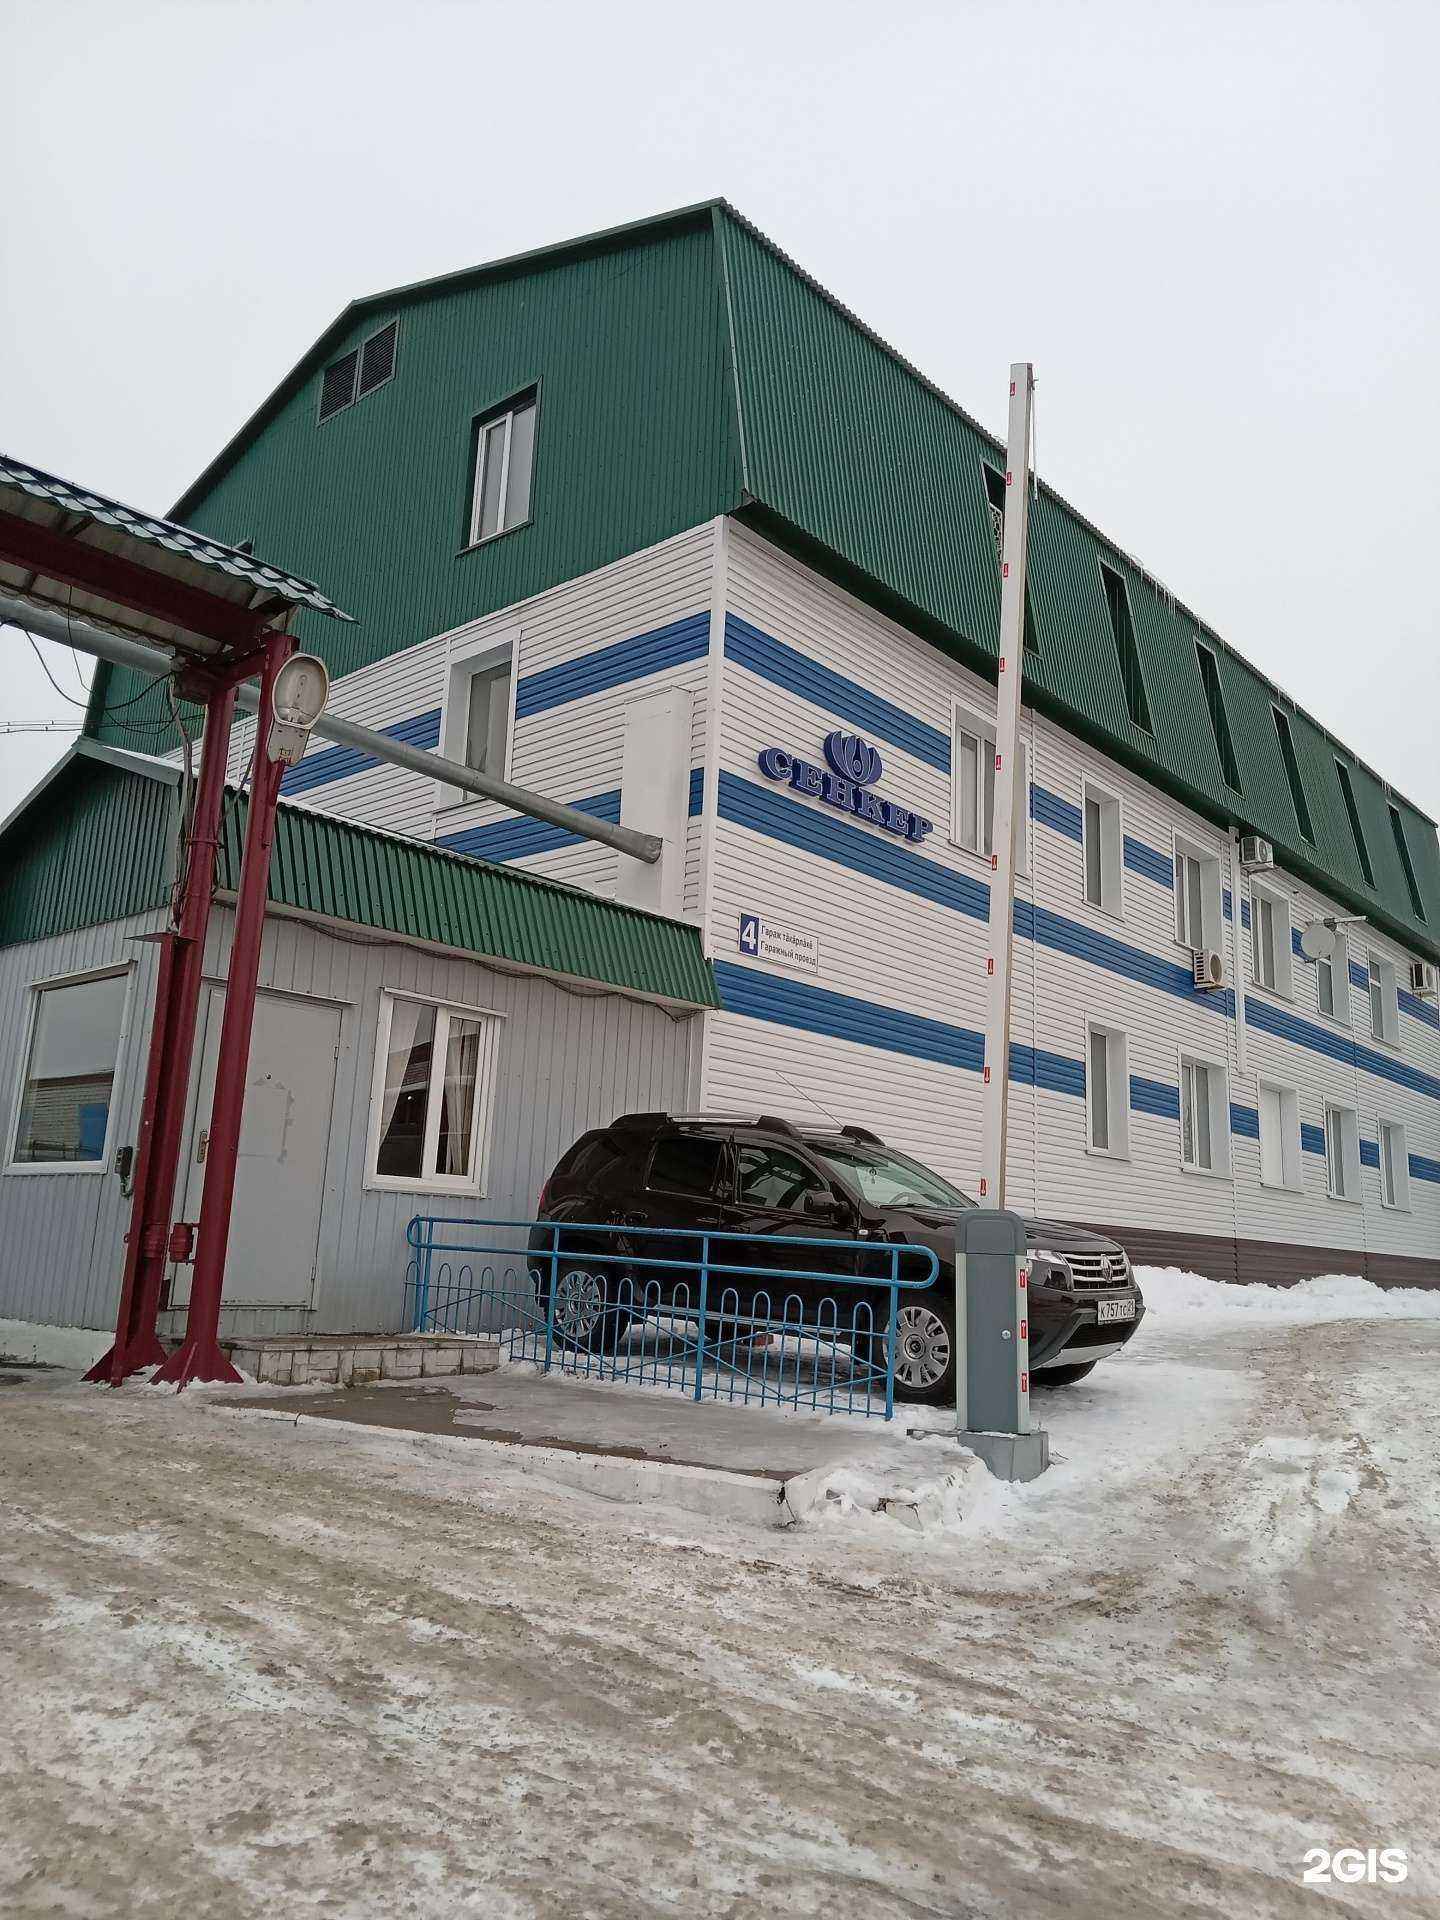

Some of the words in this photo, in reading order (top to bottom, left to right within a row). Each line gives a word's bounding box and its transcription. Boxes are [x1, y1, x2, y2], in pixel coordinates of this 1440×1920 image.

[758, 747, 934, 843] СЕНКЕР
[741, 920, 757, 950] 4
[761, 925, 781, 941] Гараж
[760, 940, 794, 960] Гаражный
[794, 952, 817, 967] проезд
